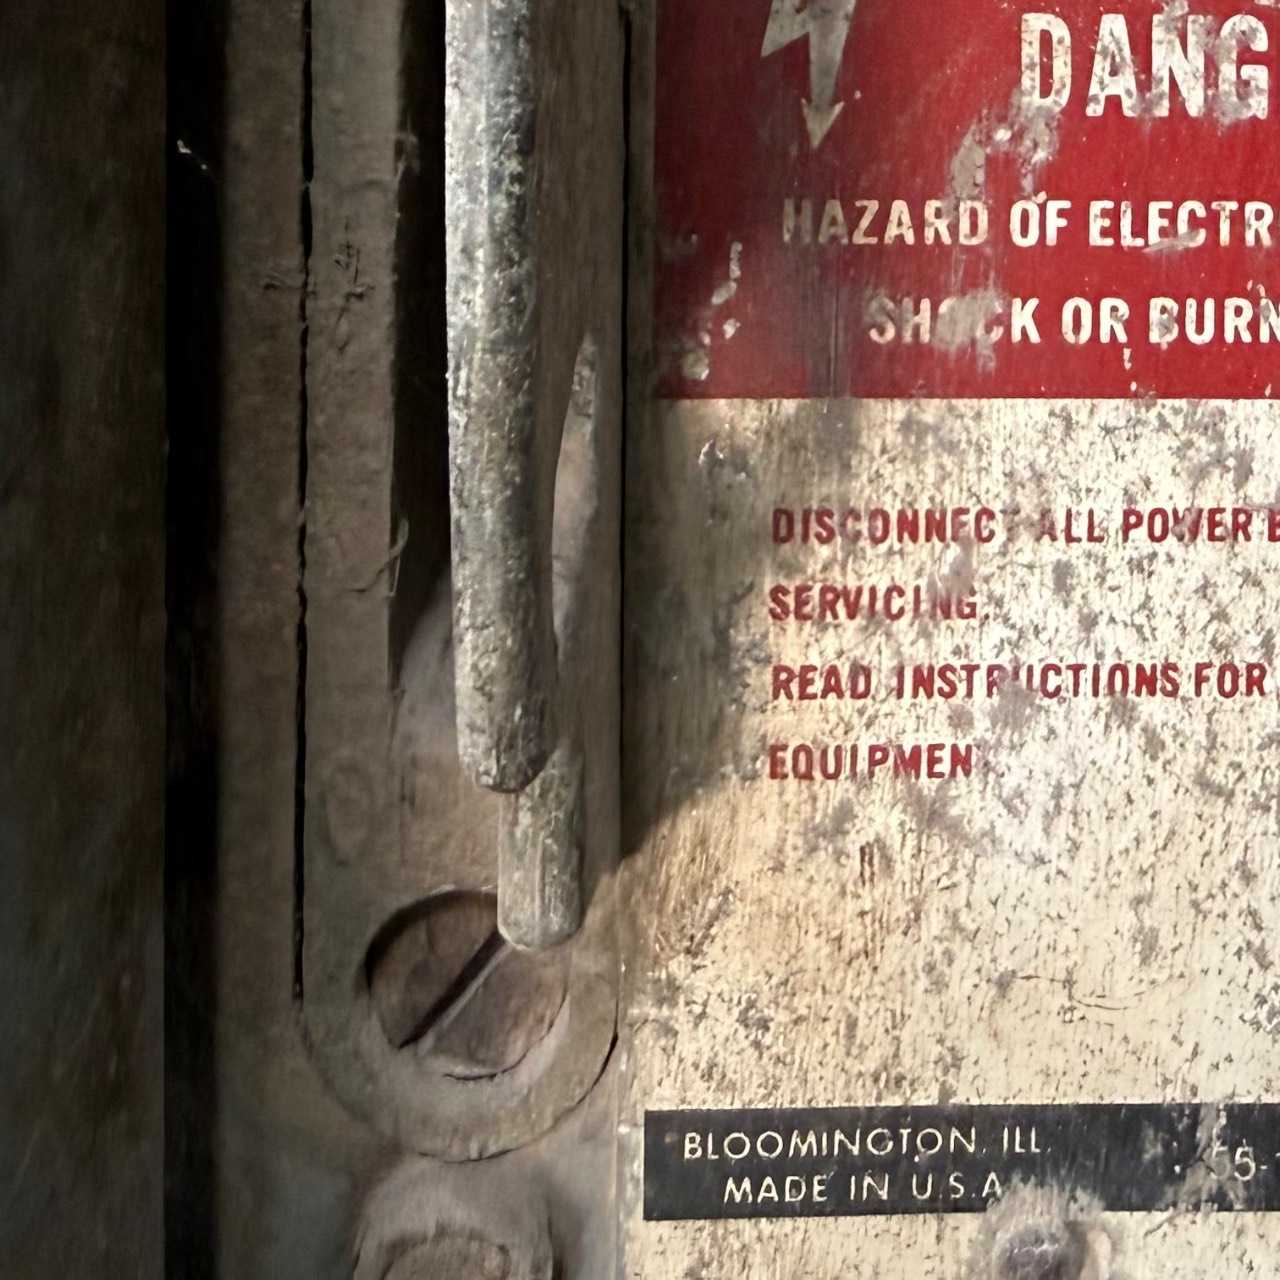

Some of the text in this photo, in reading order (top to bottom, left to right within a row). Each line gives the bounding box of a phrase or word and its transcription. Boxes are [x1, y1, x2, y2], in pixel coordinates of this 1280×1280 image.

[782, 198, 989, 247] HAZARD
[1009, 199, 1072, 247] OF
[1061, 297, 1130, 345] OR
[1036, 507, 1105, 544] ALL
[1122, 507, 1252, 543] POWER
[768, 584, 977, 621] SERVICING
[771, 664, 872, 701] READ
[1195, 662, 1268, 699] FOR
[769, 742, 973, 781] EQUIPMEN
[723, 1173, 830, 1204] MADE
[850, 1175, 889, 1201] IN
